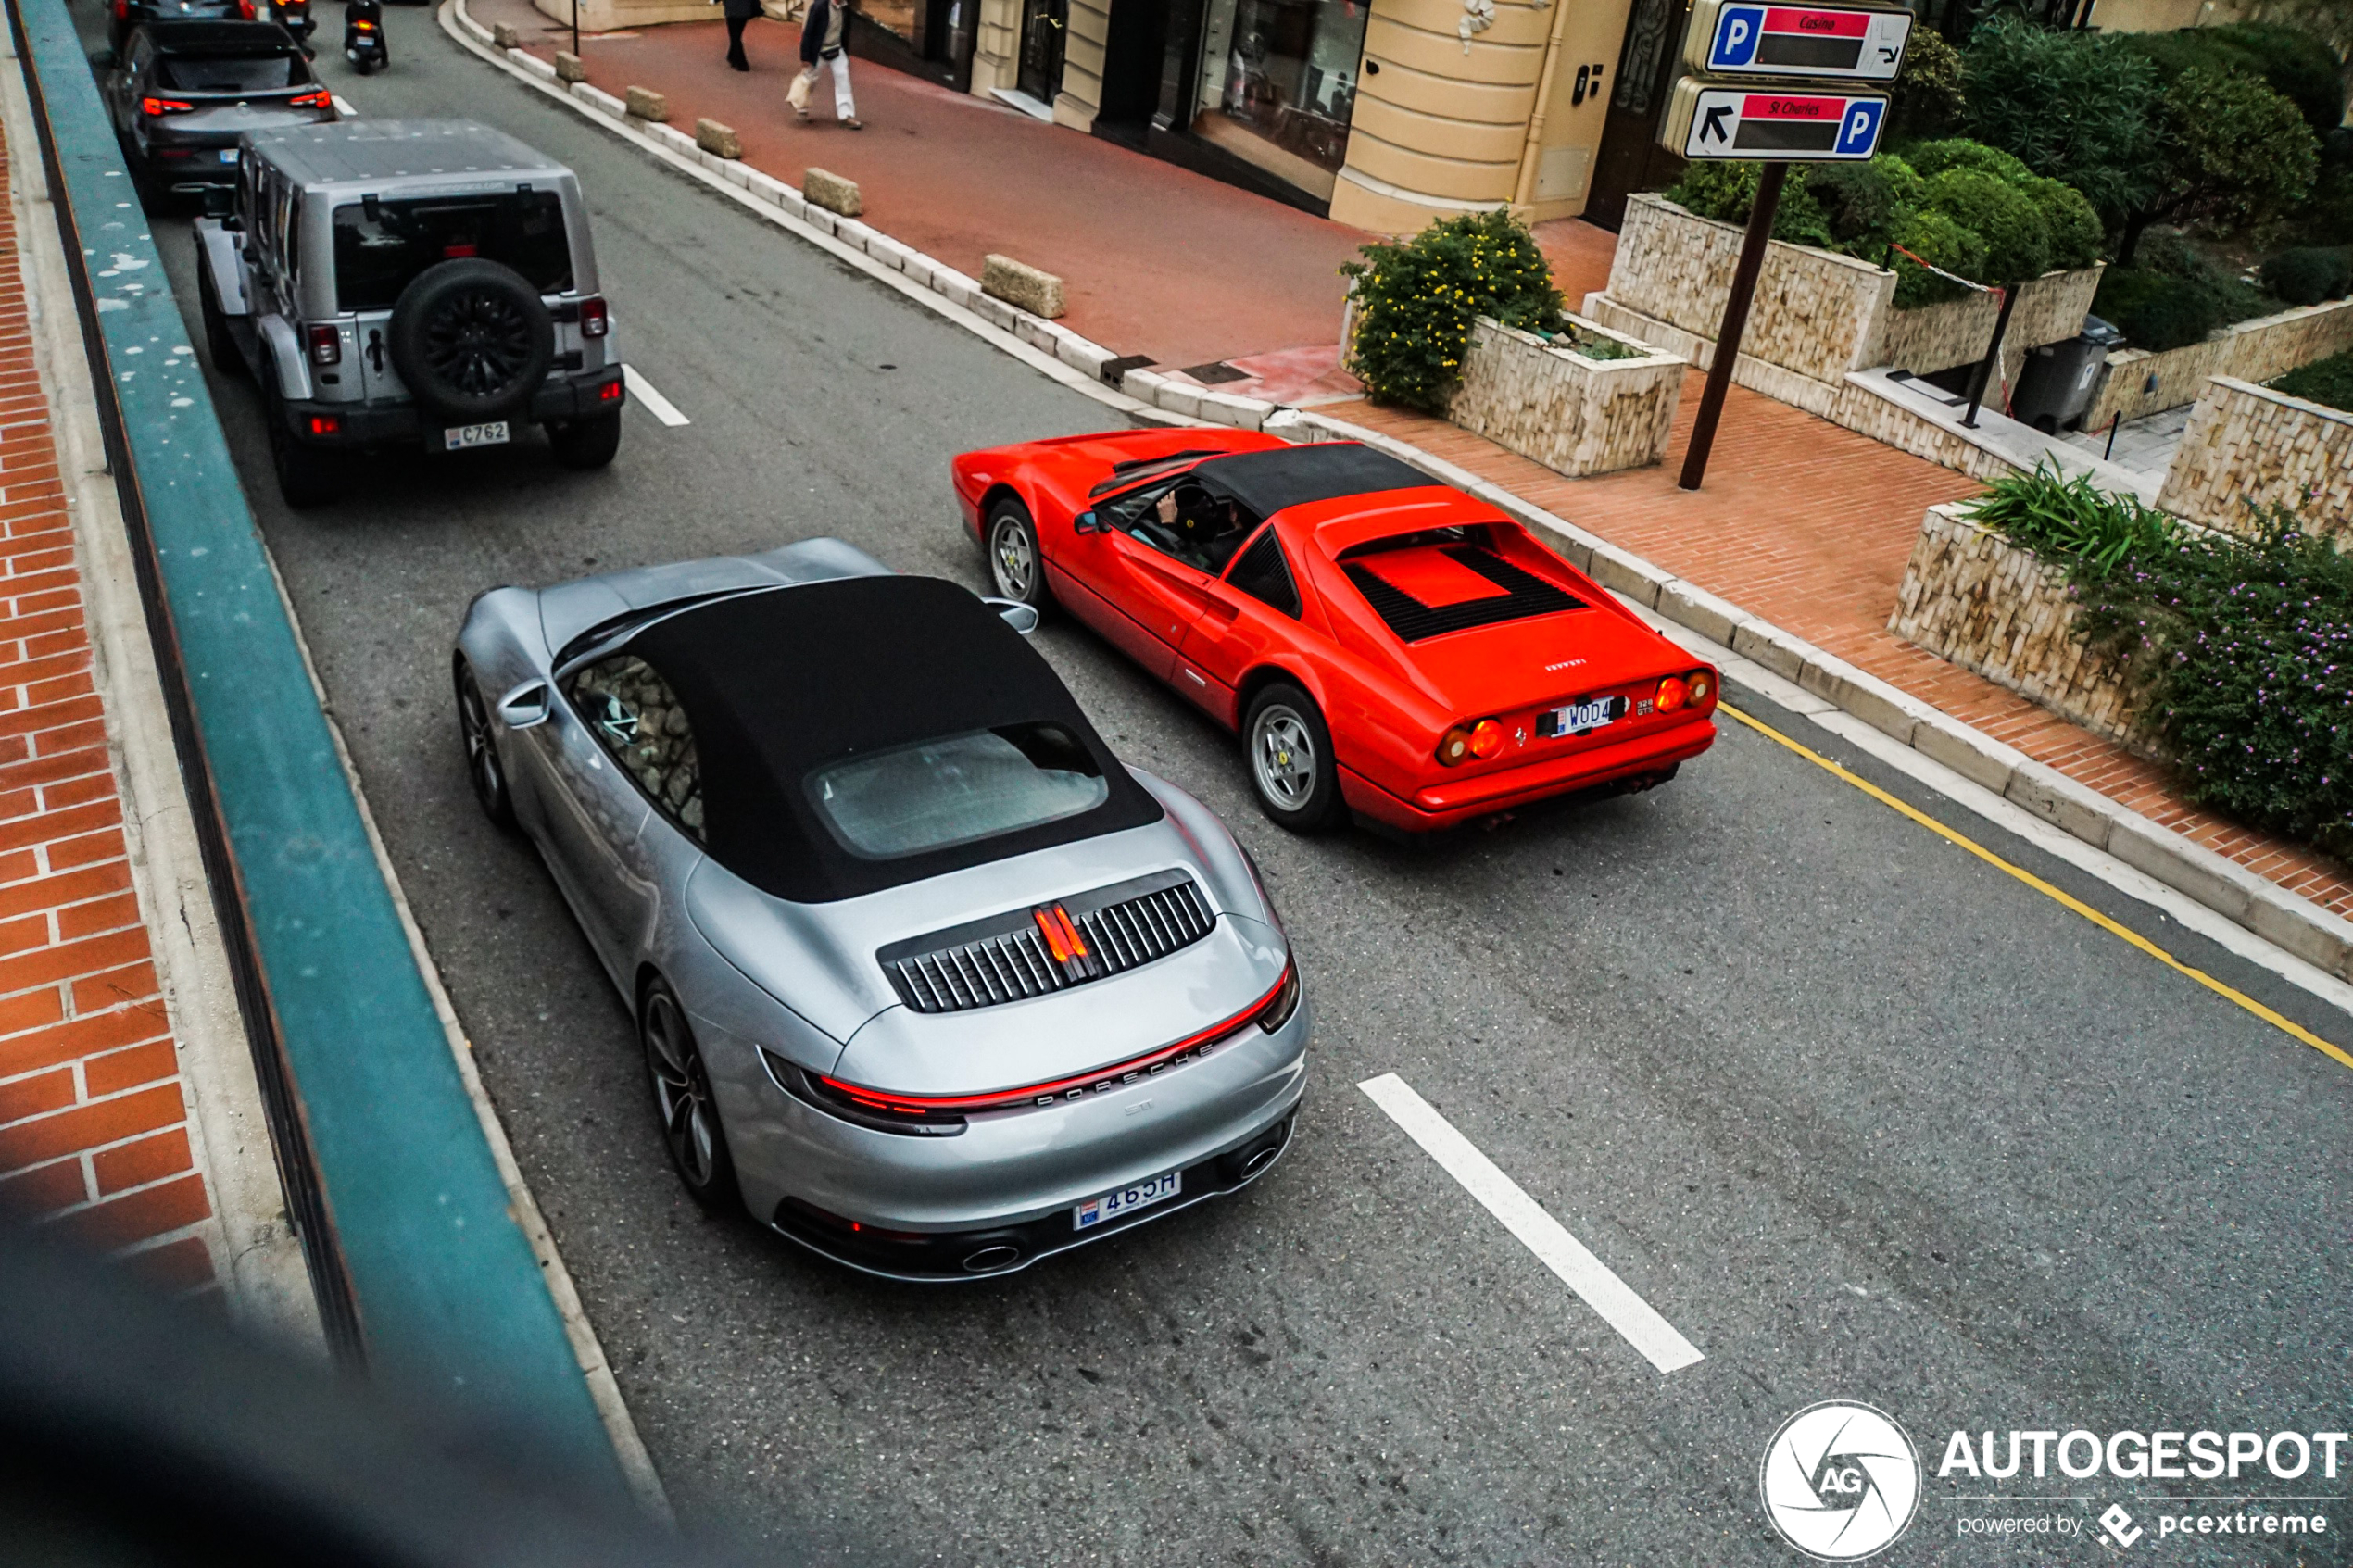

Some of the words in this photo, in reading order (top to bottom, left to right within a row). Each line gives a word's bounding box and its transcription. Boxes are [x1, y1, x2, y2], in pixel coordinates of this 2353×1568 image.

[1725, 19, 1749, 55] P
[1799, 16, 1836, 31] Casino
[1768, 101, 1780, 114] St
[1781, 102, 1820, 116] Charles
[1847, 111, 1870, 144] P
[463, 423, 504, 444] C762
[1037, 1043, 1214, 1108] PORSCHE
